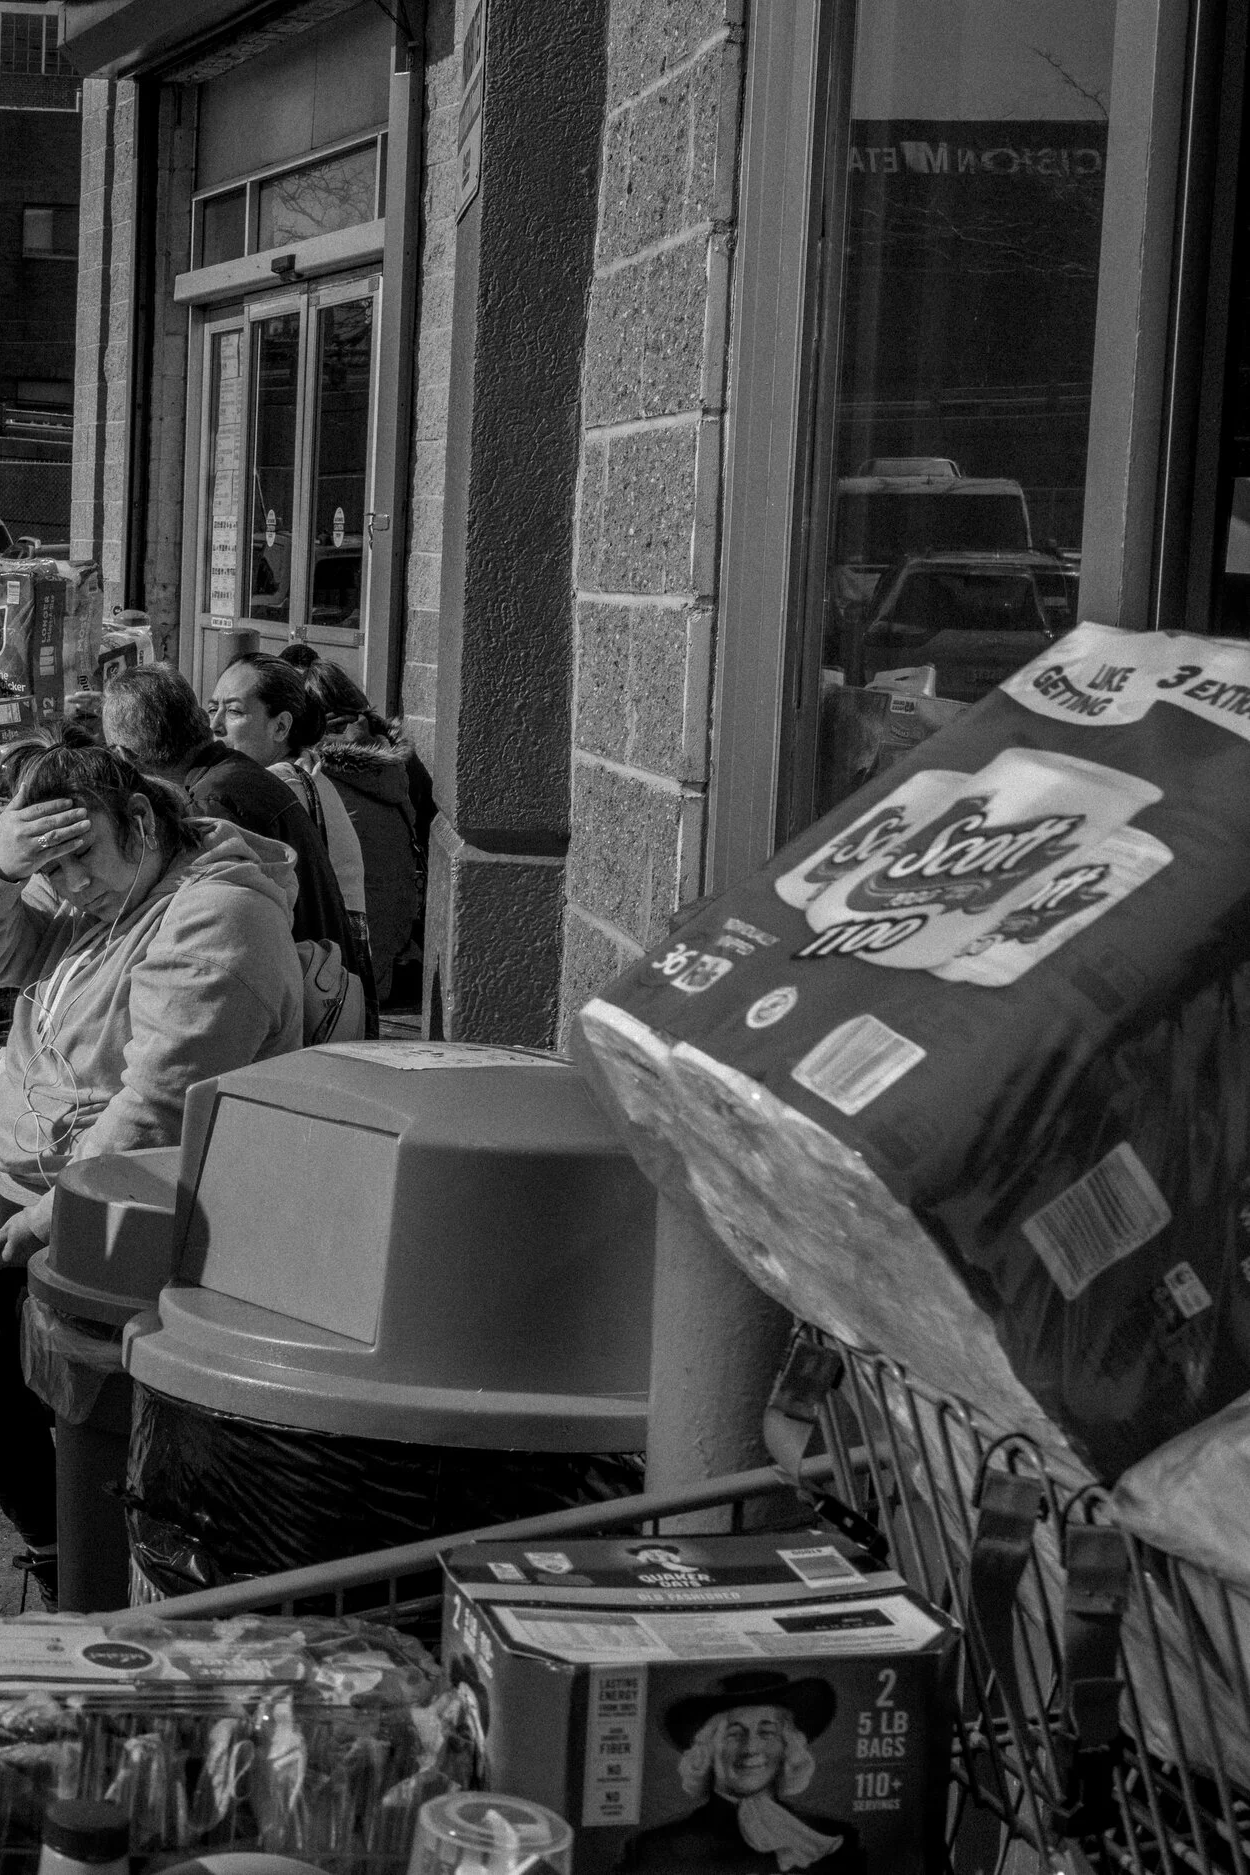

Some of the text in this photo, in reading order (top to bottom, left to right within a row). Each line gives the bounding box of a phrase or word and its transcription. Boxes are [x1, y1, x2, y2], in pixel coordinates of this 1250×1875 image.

[1086, 663, 1137, 693] LIKE
[1156, 665, 1203, 689] 3
[1032, 665, 1115, 717] GETTING
[887, 810, 1088, 879] Scott
[795, 915, 929, 957] 1100
[638, 1573, 712, 1584] QUAKER
[659, 1580, 703, 1588] OATS
[599, 1690, 639, 1701] ENERGY
[875, 1667, 898, 1708] 2
[857, 1710, 909, 1736] 5 LB
[855, 1736, 907, 1758] BAGS
[854, 1772, 903, 1798] 110+
